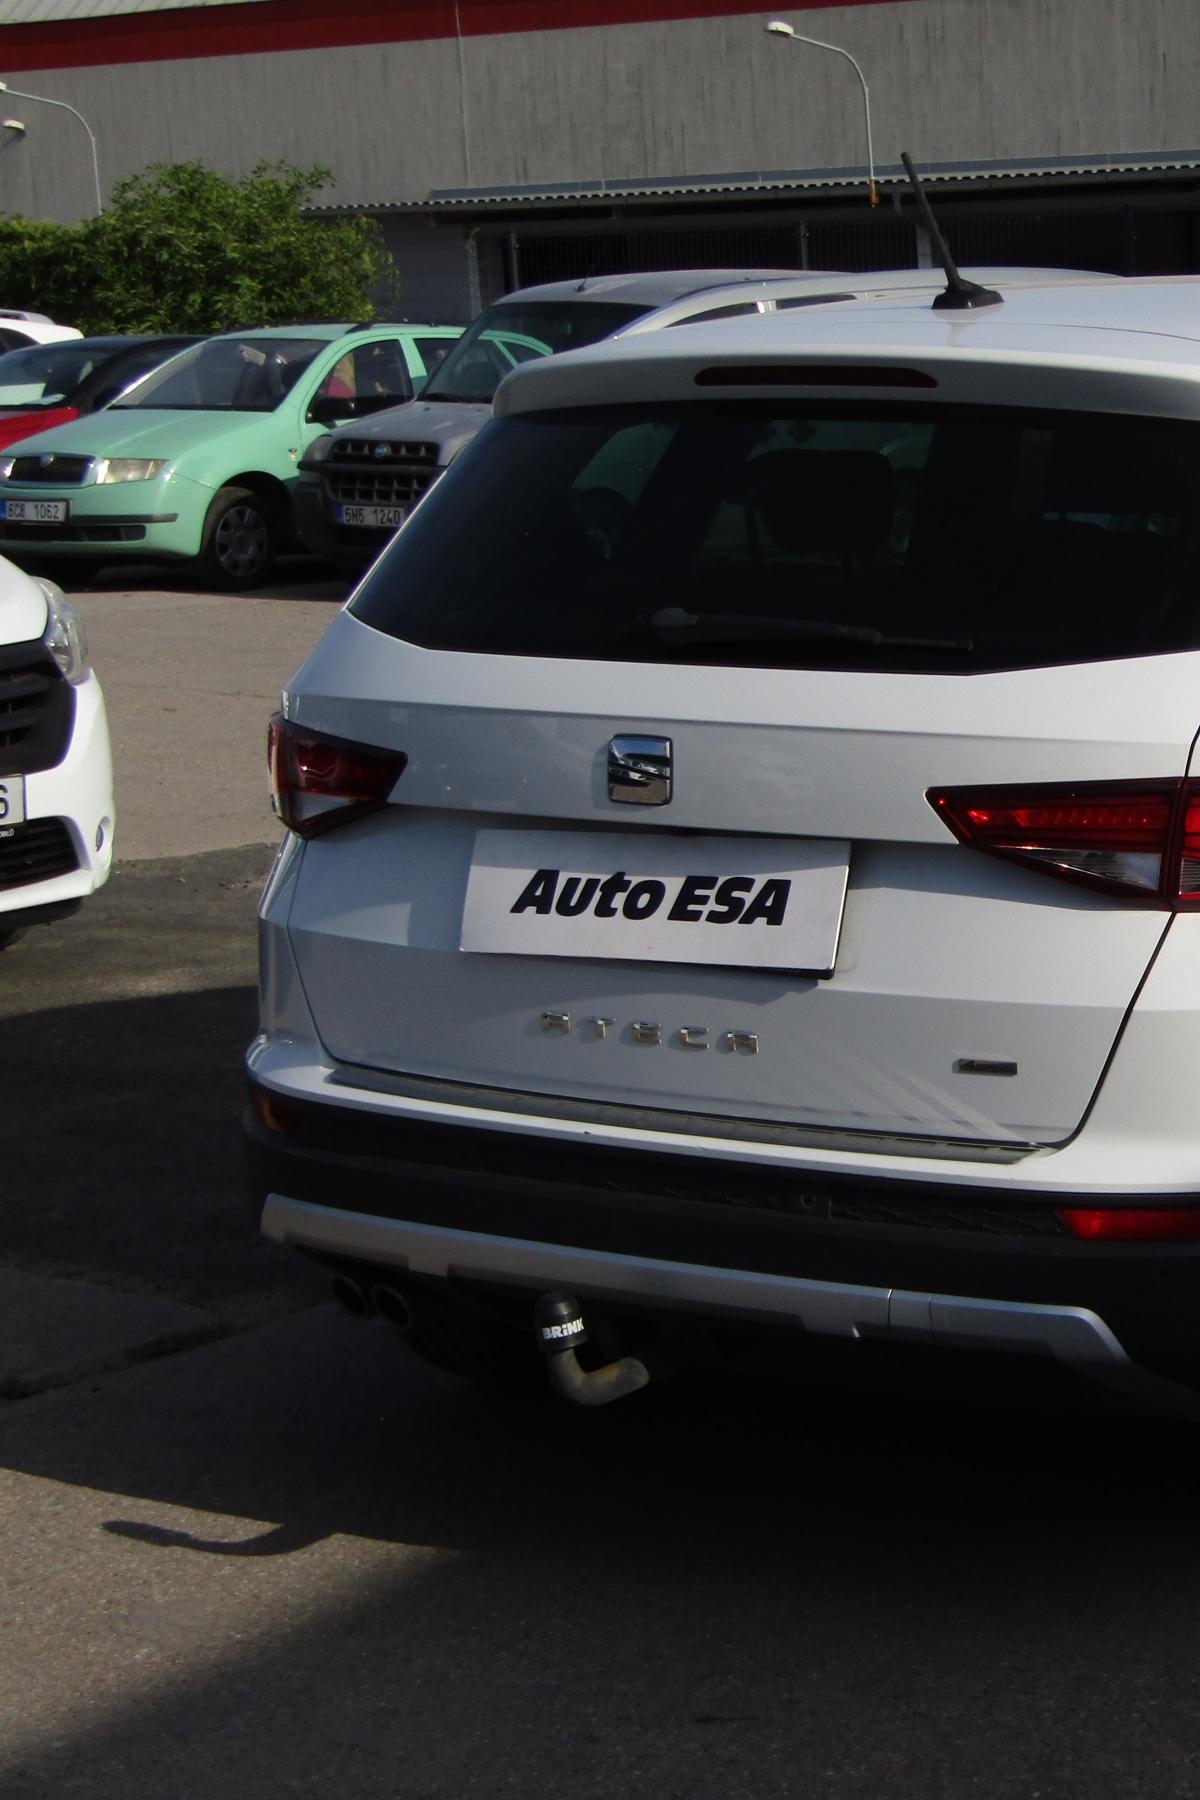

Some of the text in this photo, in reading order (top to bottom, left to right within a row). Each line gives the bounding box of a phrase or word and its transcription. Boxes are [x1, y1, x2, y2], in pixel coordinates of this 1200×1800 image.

[33, 503, 60, 520] 1062
[345, 507, 401, 525] 5H5 1240
[509, 868, 792, 926] Auto ESA
[541, 1010, 759, 1053] ATECA
